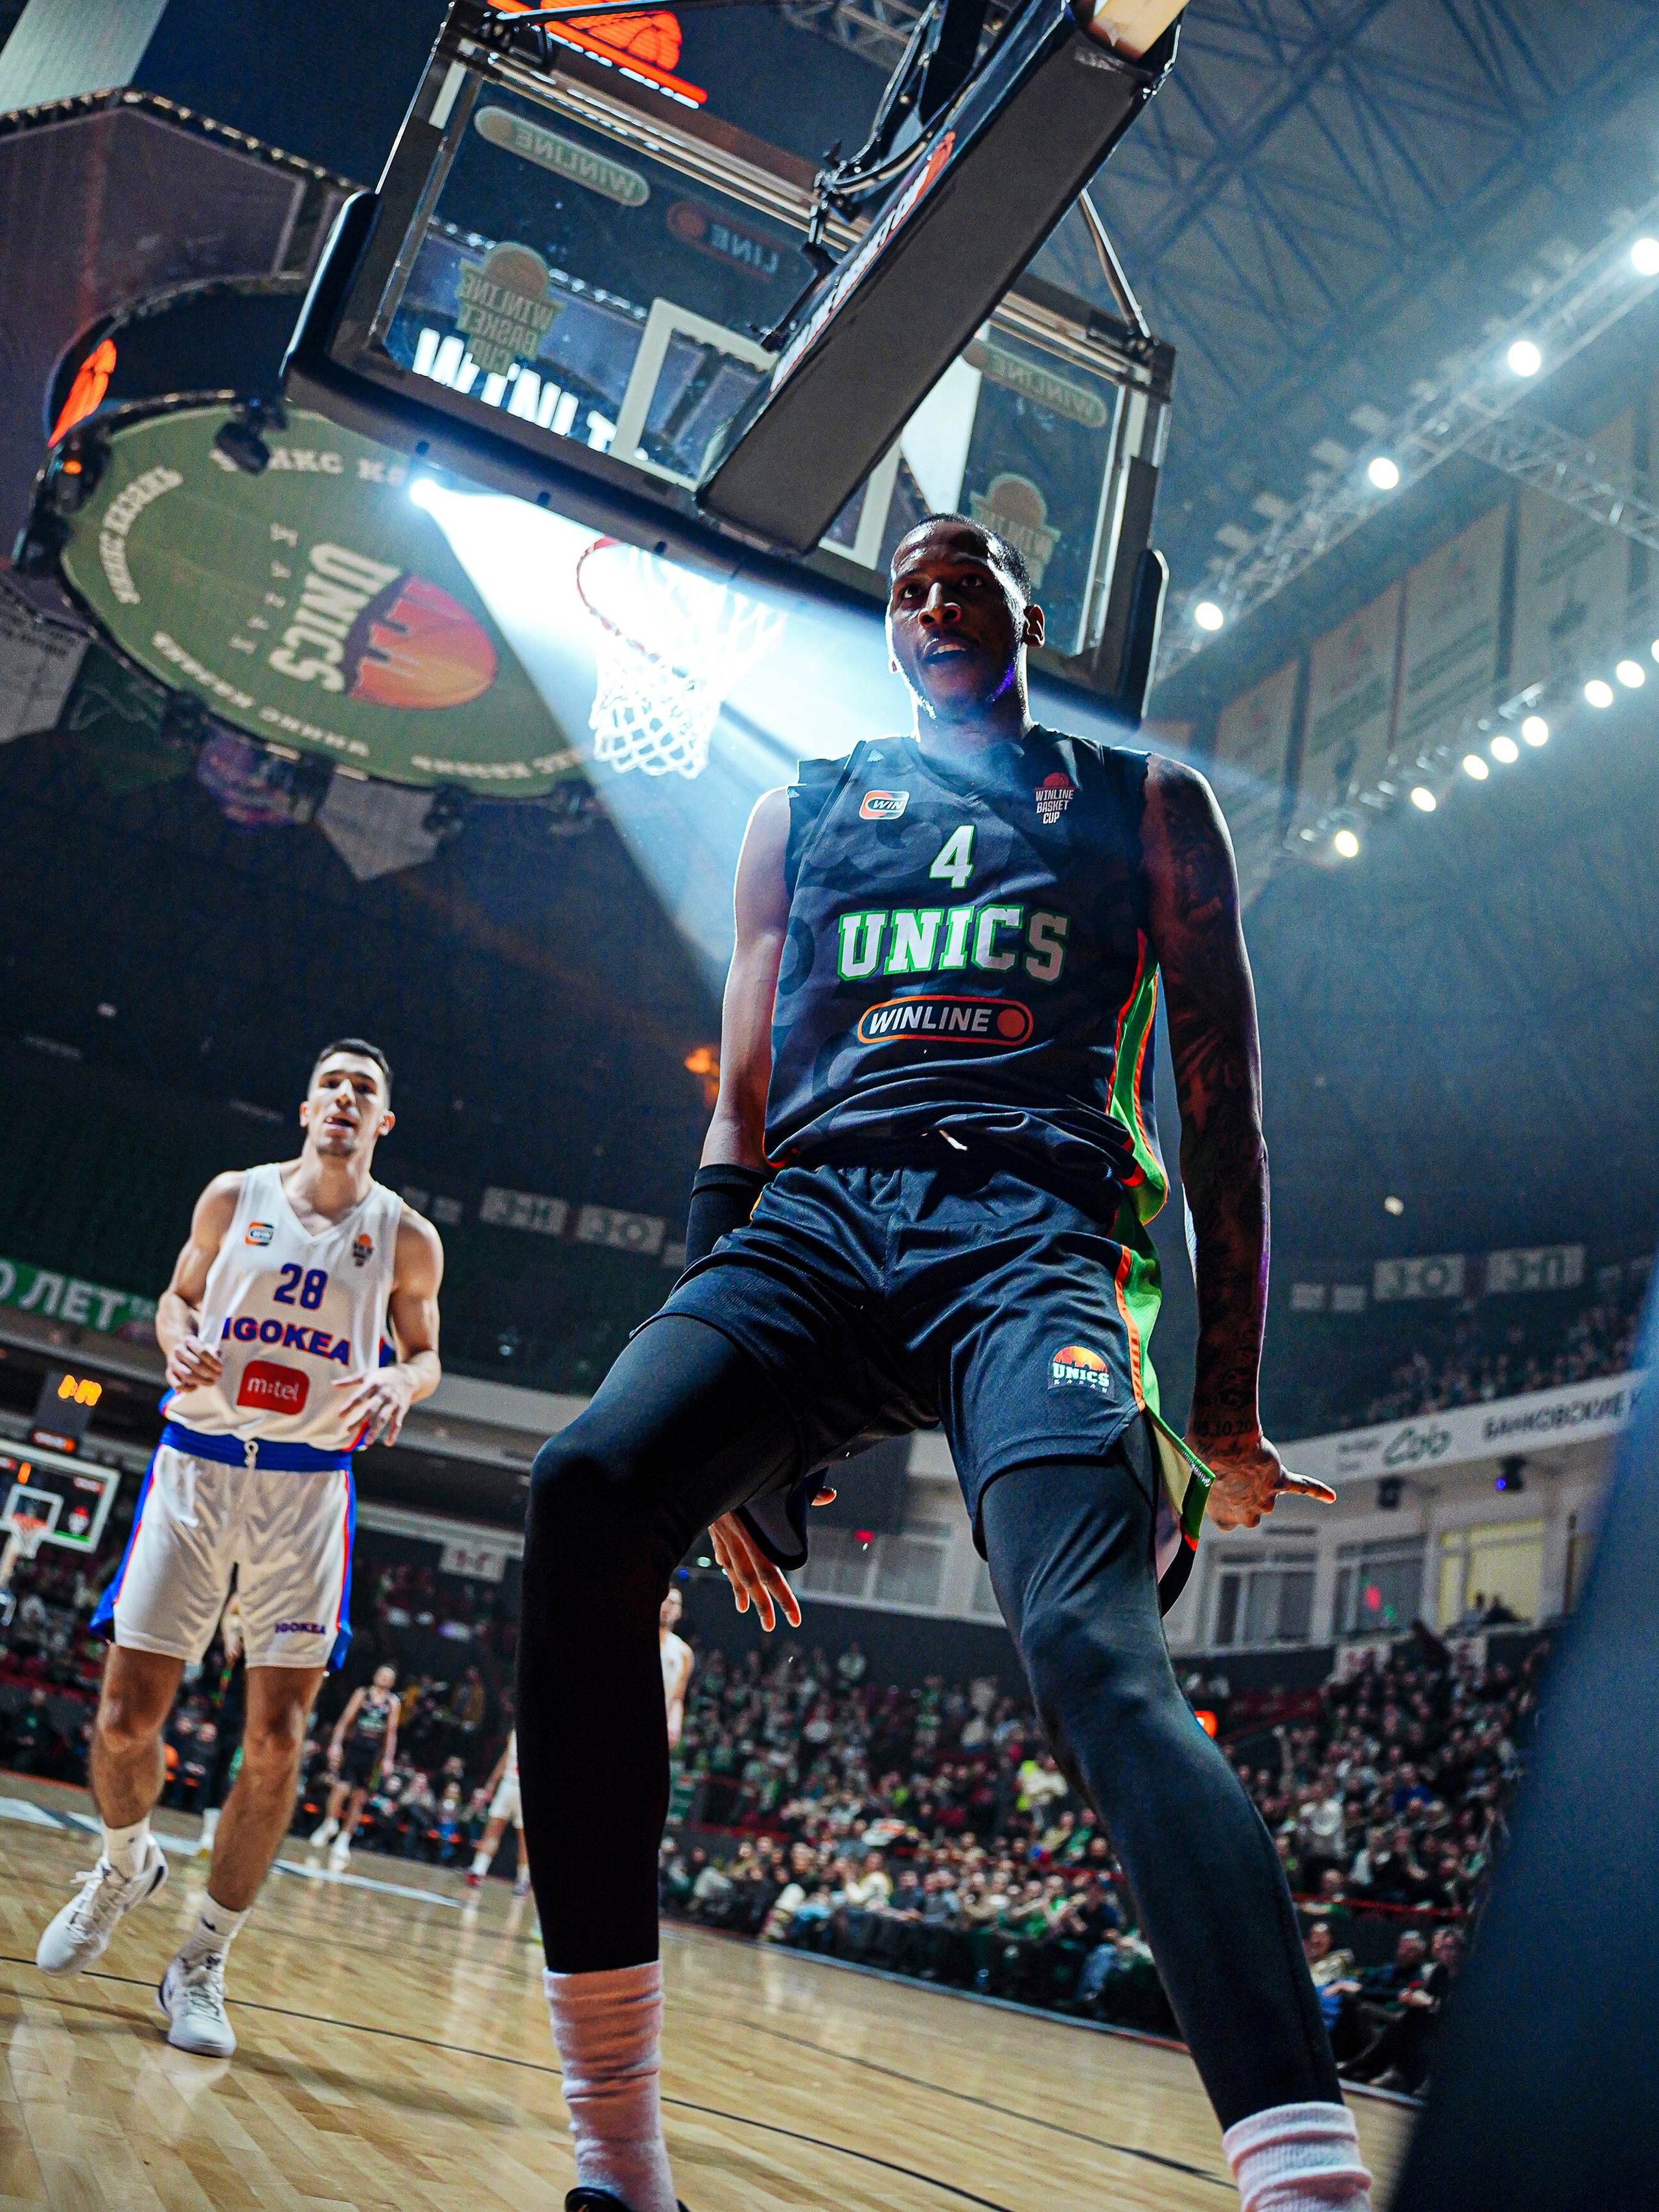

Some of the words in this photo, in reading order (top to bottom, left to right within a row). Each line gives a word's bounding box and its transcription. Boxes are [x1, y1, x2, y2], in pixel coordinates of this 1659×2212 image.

[269, 542, 402, 692] UNICS
[872, 799, 905, 810] WIN
[1036, 789, 1074, 801] WINLINE
[1037, 800, 1069, 814] BASKET
[1043, 811, 1060, 824] CUP
[929, 825, 975, 889] 4
[837, 903, 1071, 984] UNICS
[868, 1007, 992, 1034] WINLINE
[19, 1270, 128, 1331] ЛЕТ
[273, 1263, 327, 1309] 28
[222, 1316, 353, 1366] IGOKEA
[246, 1373, 300, 1402] m:tel
[1052, 1362, 1110, 1388] UNICS
